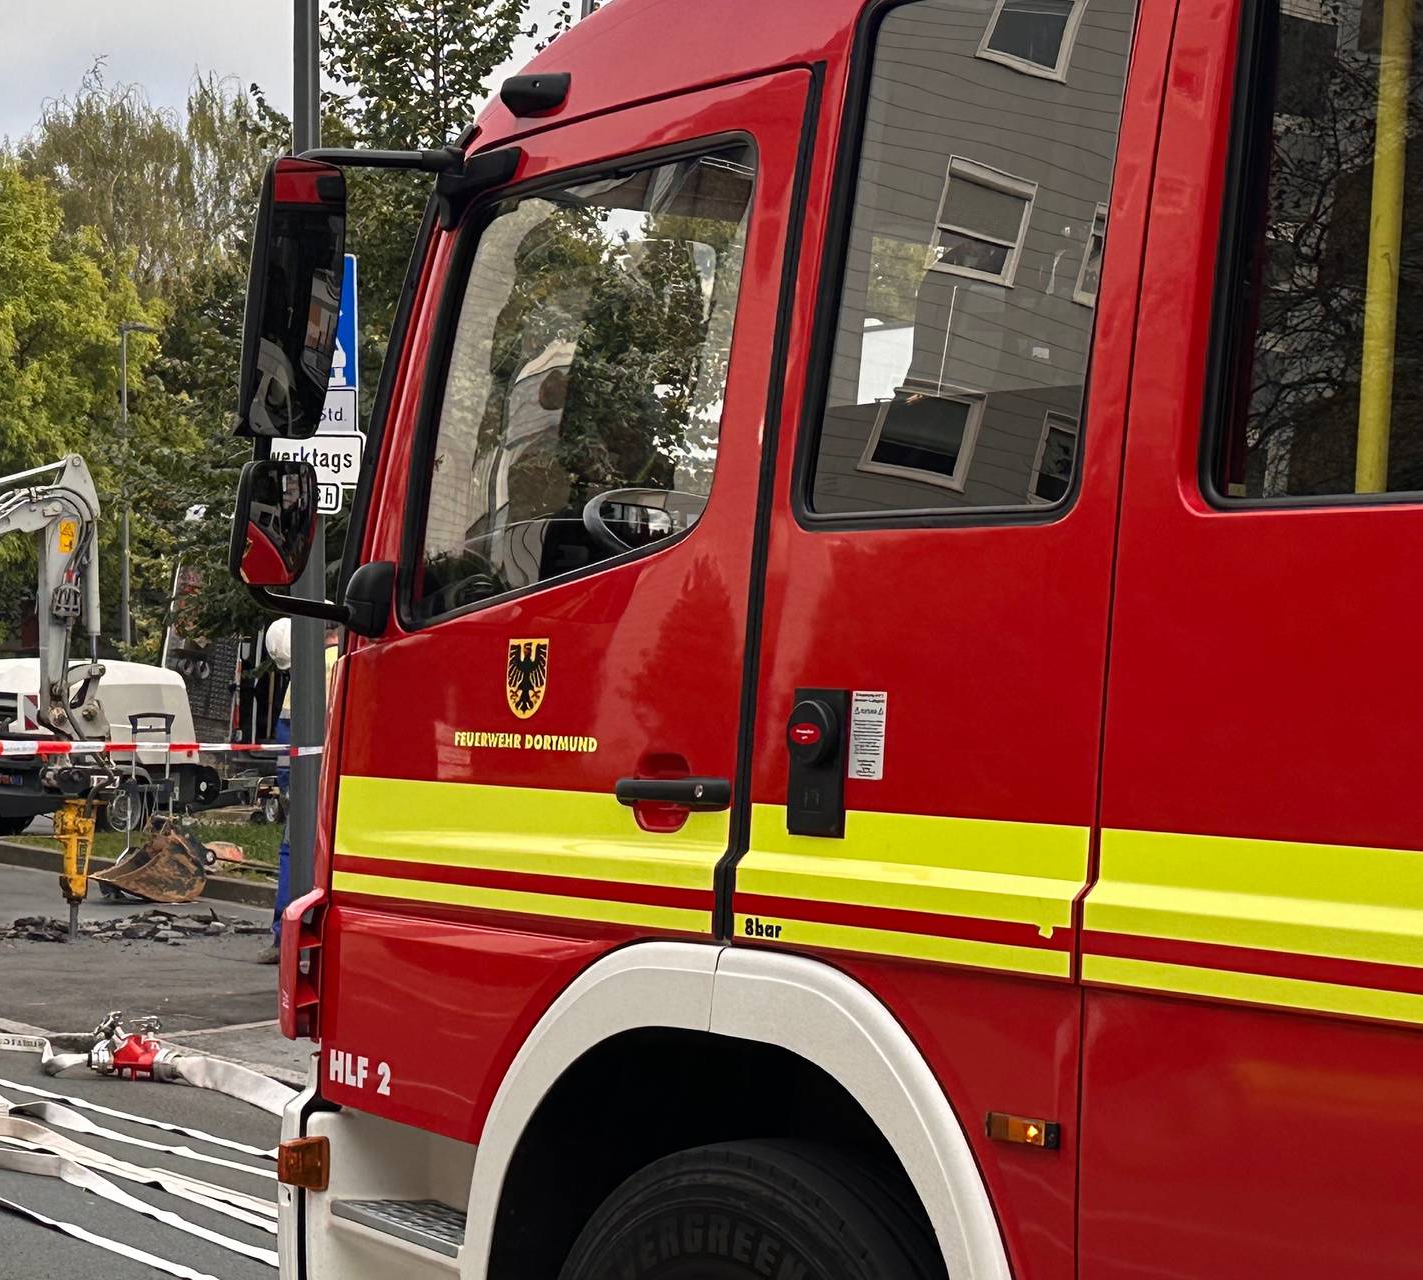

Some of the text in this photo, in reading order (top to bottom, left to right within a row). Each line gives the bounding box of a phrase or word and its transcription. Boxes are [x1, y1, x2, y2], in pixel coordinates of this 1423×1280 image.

[454, 731, 598, 753] FEUERWEHR DORTMUND
[329, 1048, 391, 1096] HLF 2
